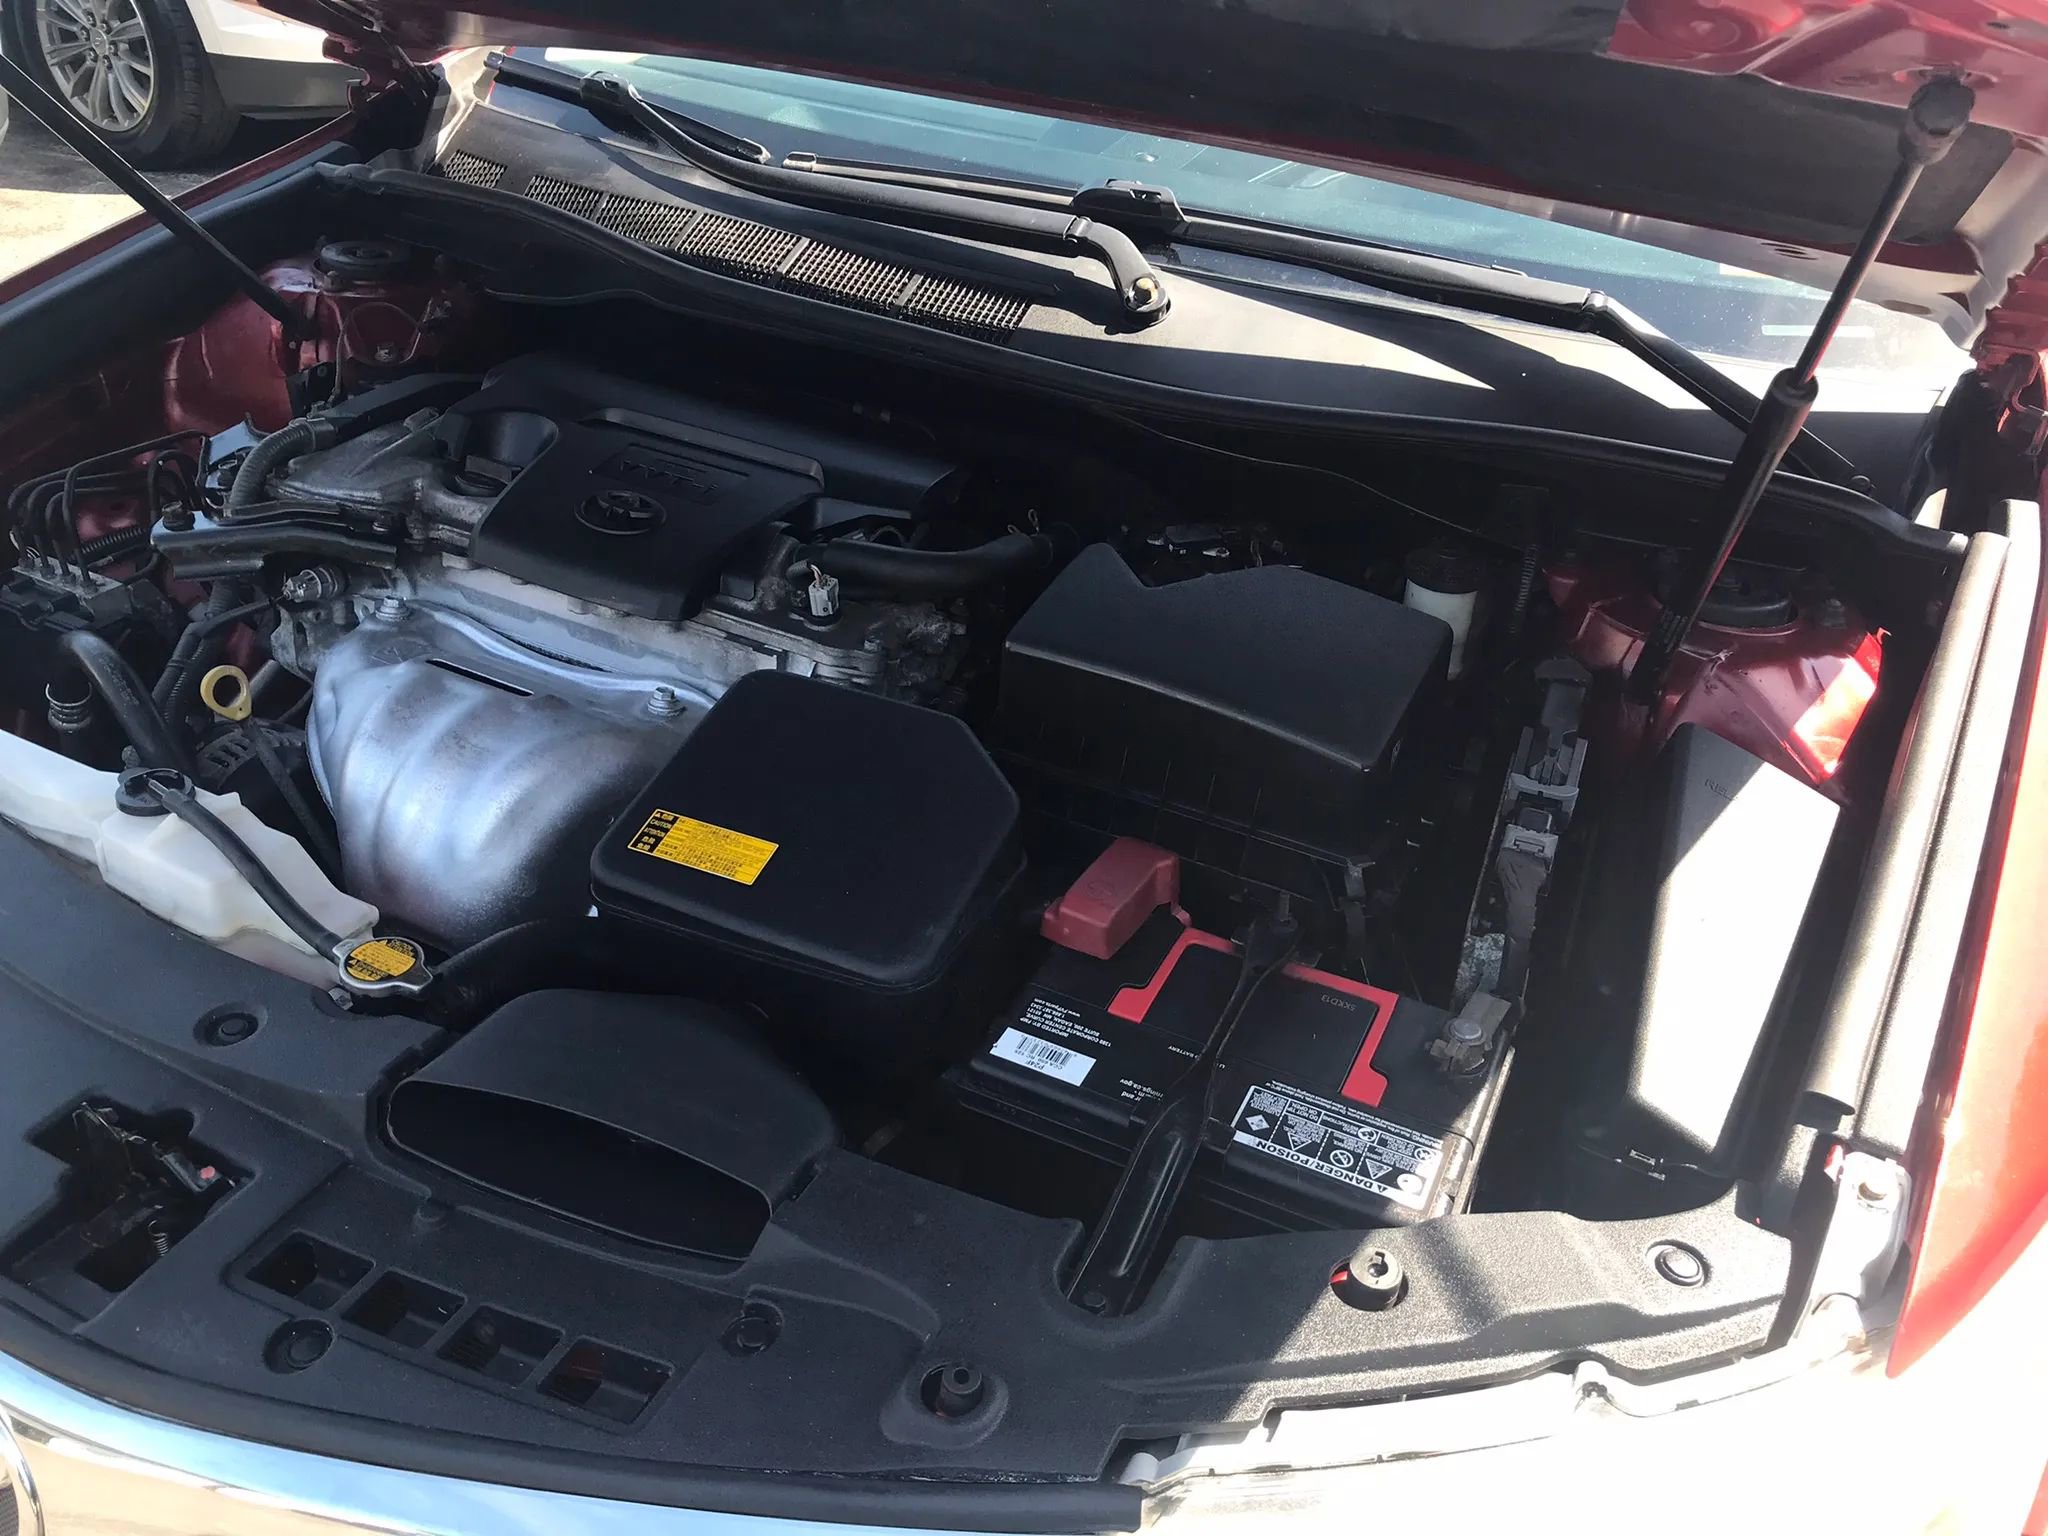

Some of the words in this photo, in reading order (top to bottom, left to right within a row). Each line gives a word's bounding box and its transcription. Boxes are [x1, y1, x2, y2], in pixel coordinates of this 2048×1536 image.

[649, 819, 672, 828] CAUTION
[1044, 1019, 1066, 1030] CENTER
[1040, 1024, 1068, 1037] IMPORTED
[1066, 1027, 1099, 1042] CORPORATE
[1121, 1090, 1134, 1099] and
[1295, 1109, 1309, 1117] NOT
[1255, 1139, 1373, 1190] DANGER/POISON
